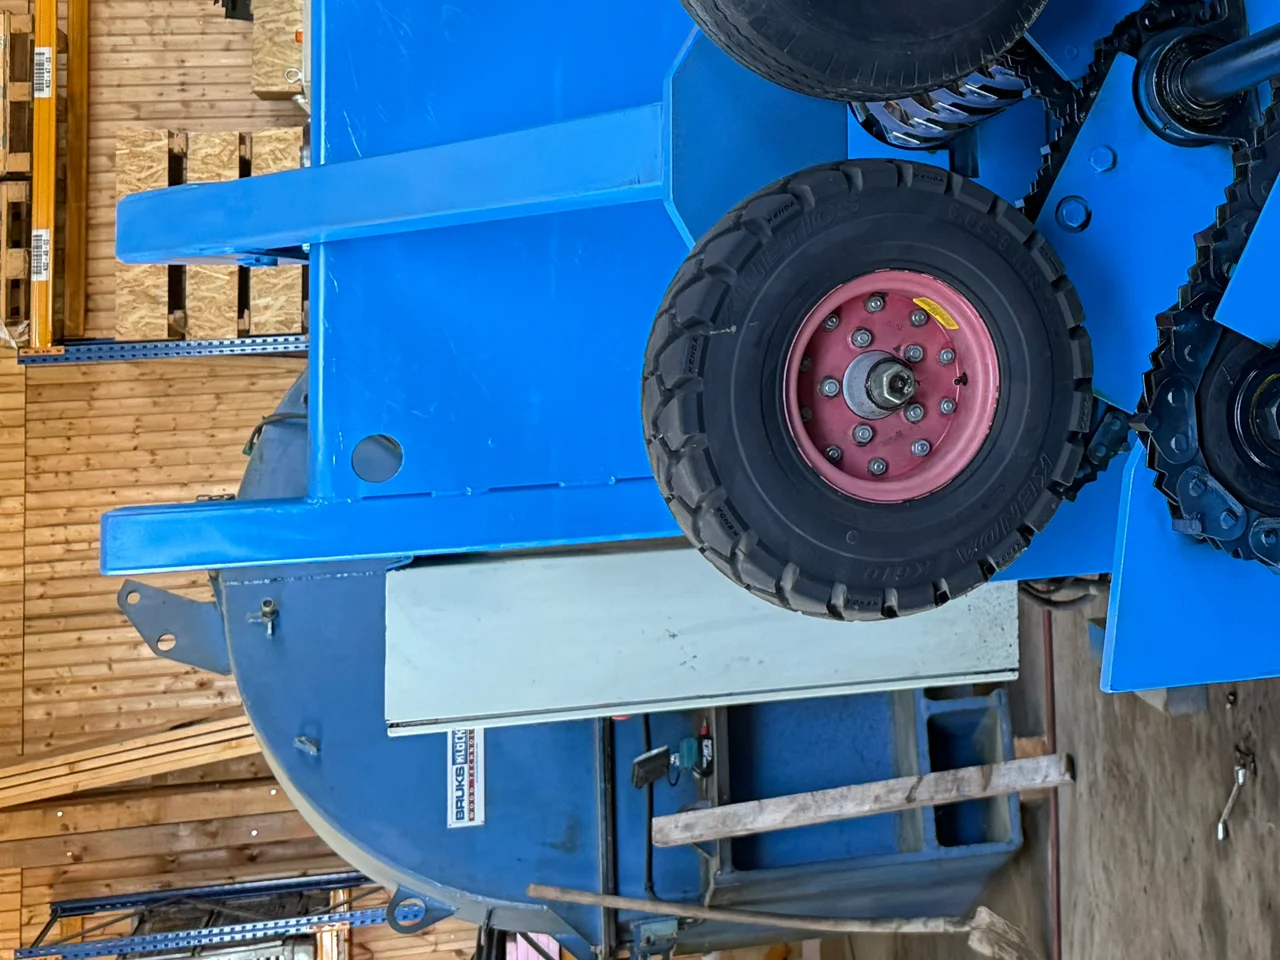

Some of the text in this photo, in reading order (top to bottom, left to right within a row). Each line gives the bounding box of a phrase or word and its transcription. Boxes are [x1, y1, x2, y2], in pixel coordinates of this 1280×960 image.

[766, 200, 797, 224] KENDA
[687, 336, 700, 374] KENDA
[955, 451, 1053, 564] KENDA
[455, 766, 465, 821] BRUKS
